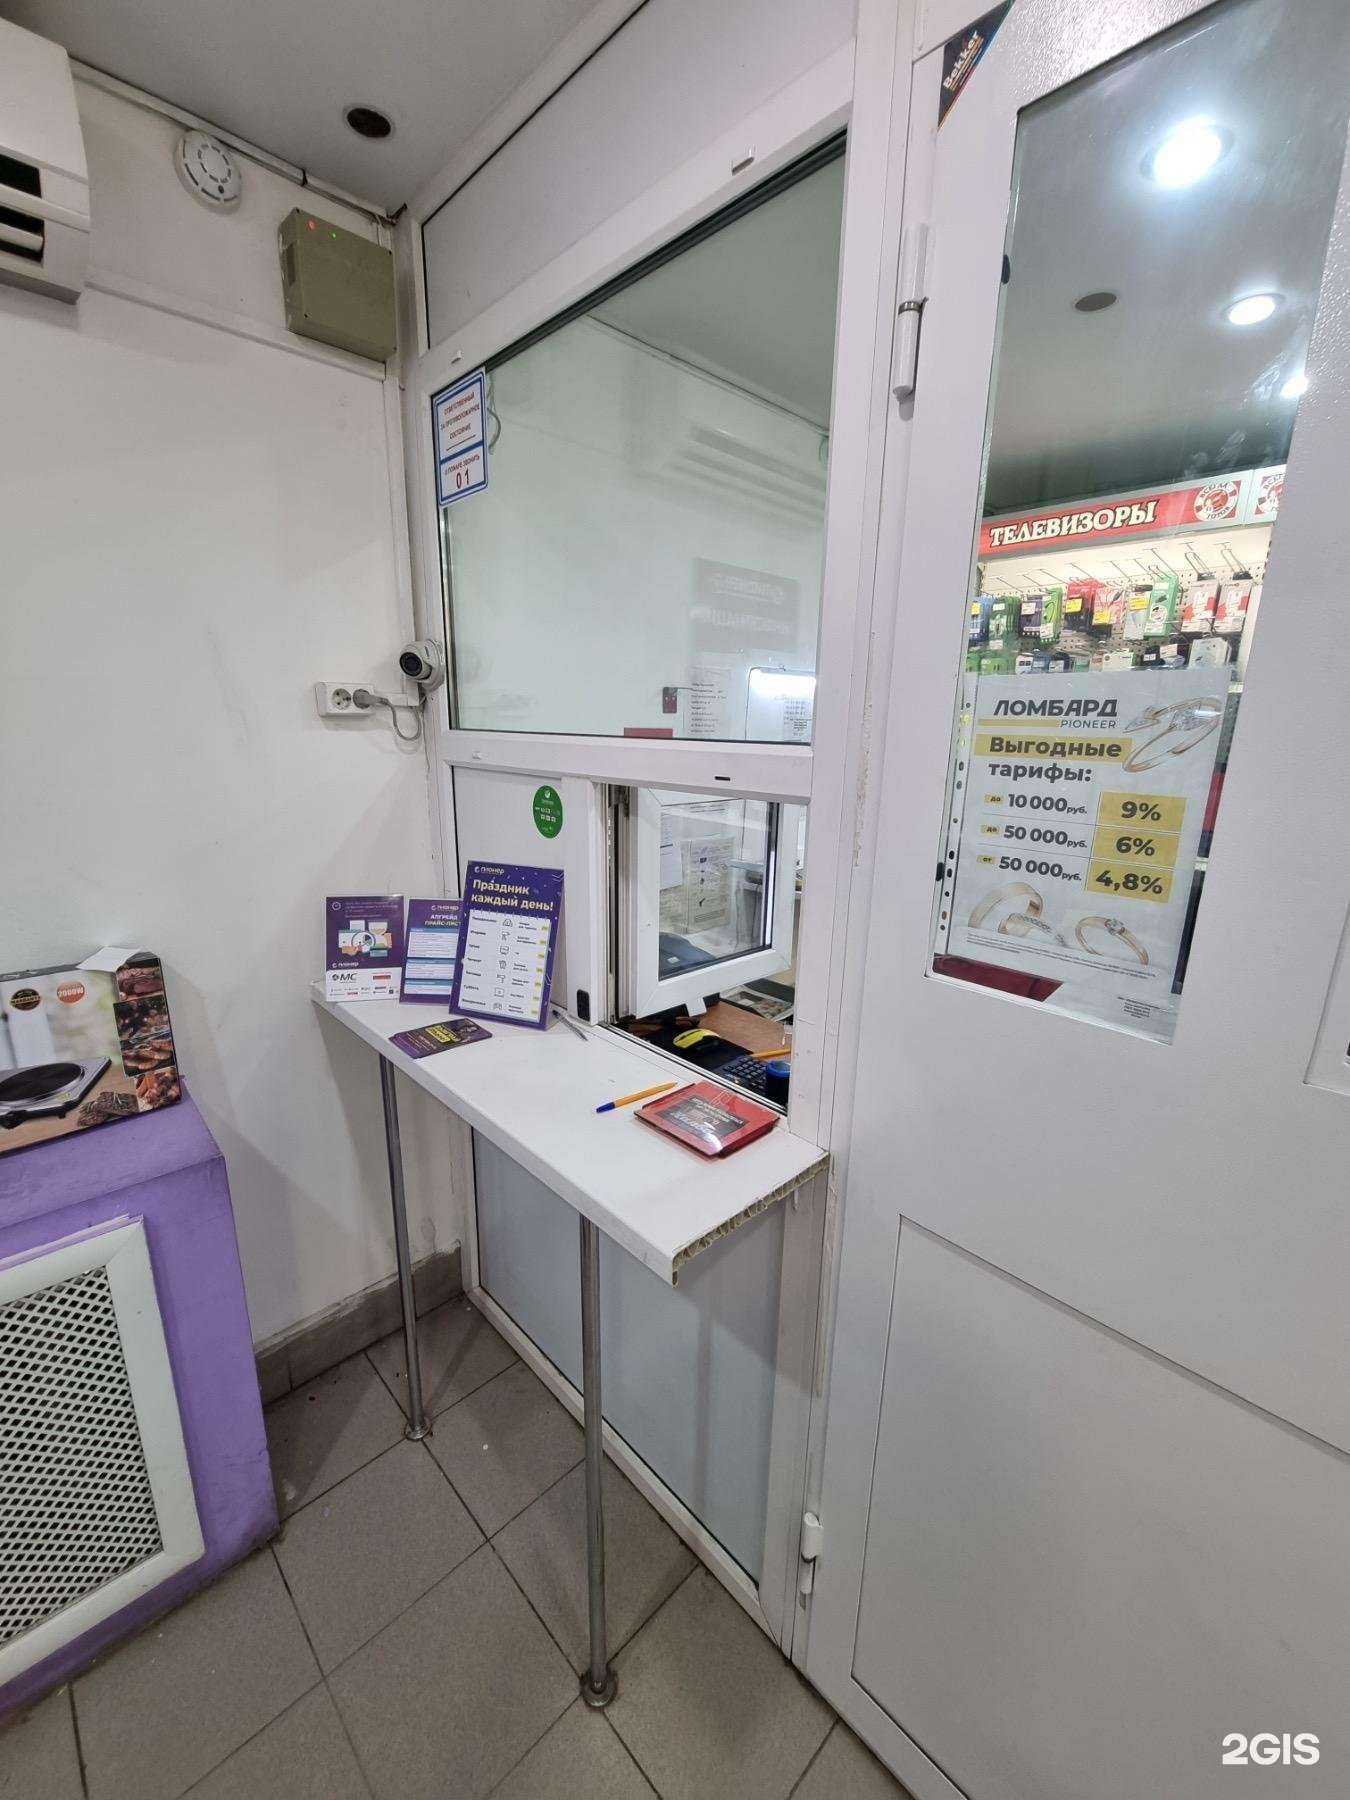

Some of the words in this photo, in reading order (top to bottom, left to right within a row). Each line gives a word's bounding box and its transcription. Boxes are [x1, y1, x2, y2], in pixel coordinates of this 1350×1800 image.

[943, 30, 979, 89] Bekker
[989, 499, 1160, 547] ТЕЛЕВИЗОРЫ
[993, 699, 1118, 717] ЛОМБАРД
[1060, 719, 1117, 729] PIONEER
[989, 736, 1122, 757] Выгодные
[988, 762, 1092, 783] тарифы:
[1121, 801, 1162, 822] 9%
[1116, 836, 1156, 857] 6%
[472, 879, 530, 895] Праздник
[1096, 869, 1163, 895] 4,8%
[471, 893, 518, 907] каждый
[520, 901, 554, 911] день!
